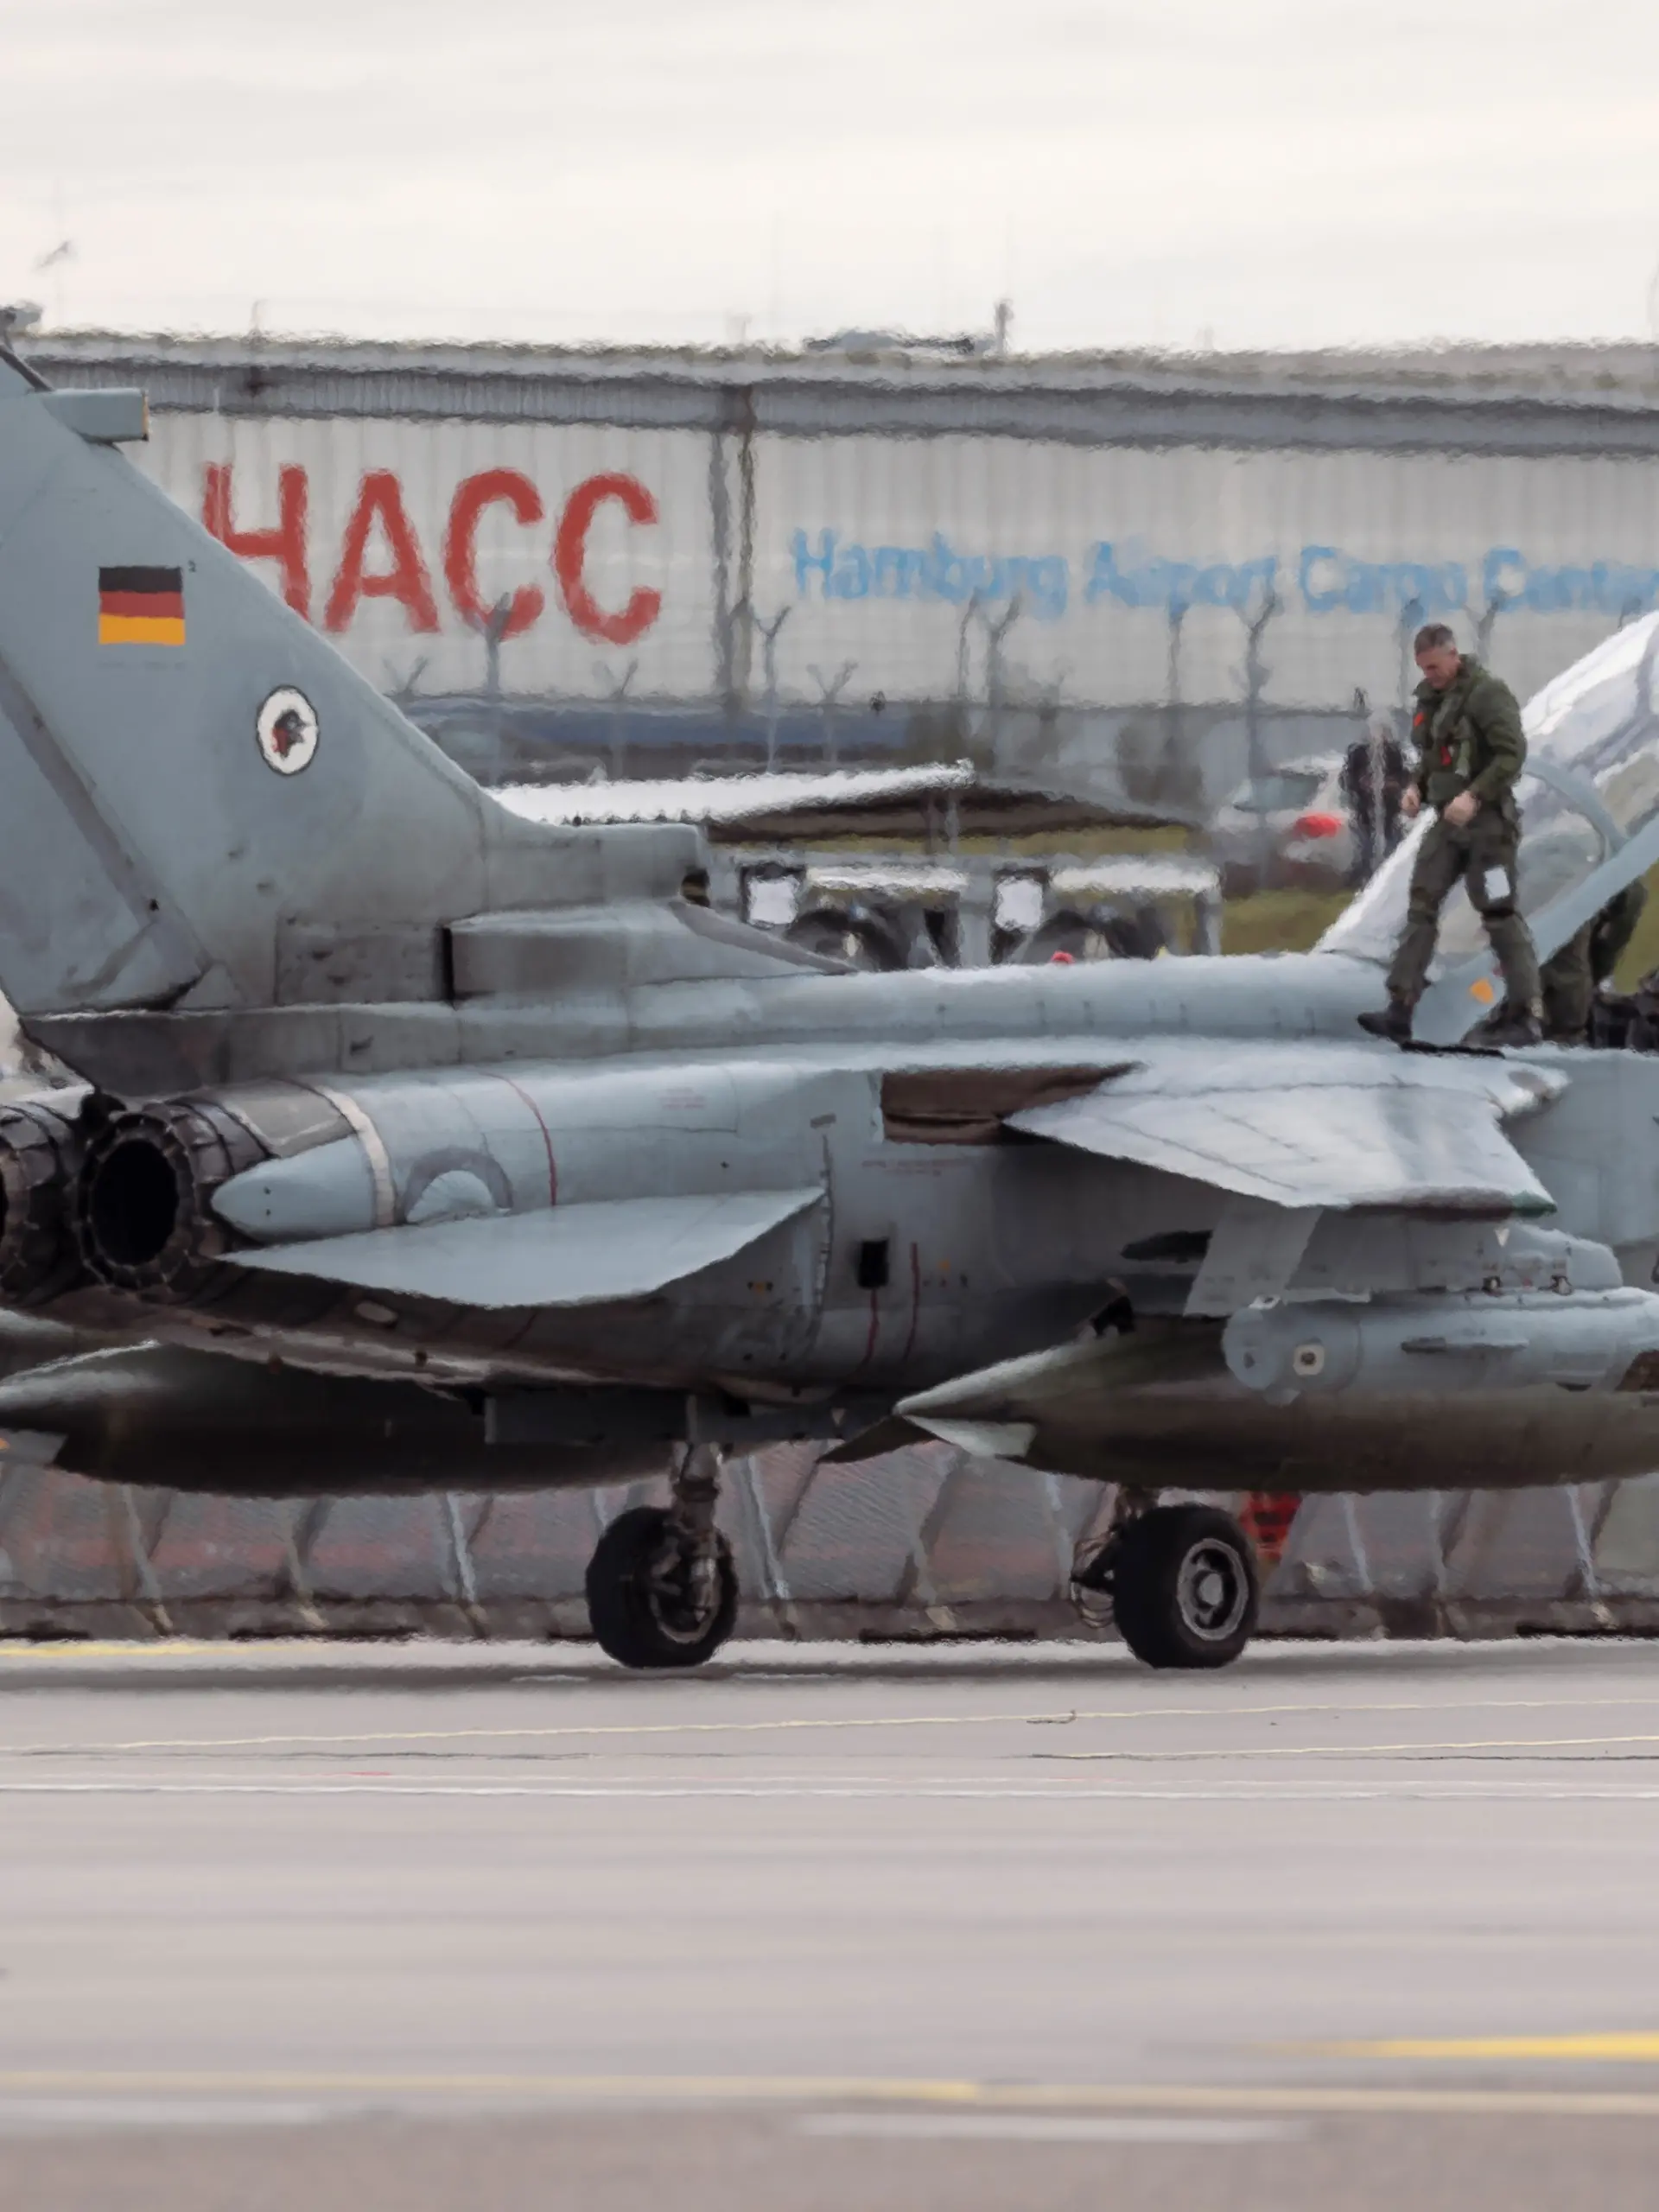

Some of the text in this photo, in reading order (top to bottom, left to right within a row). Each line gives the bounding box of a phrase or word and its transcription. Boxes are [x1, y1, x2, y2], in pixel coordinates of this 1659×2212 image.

[202, 461, 662, 646] HACC
[791, 528, 1070, 621] Hamburg
[1298, 544, 1468, 624] Cargo
